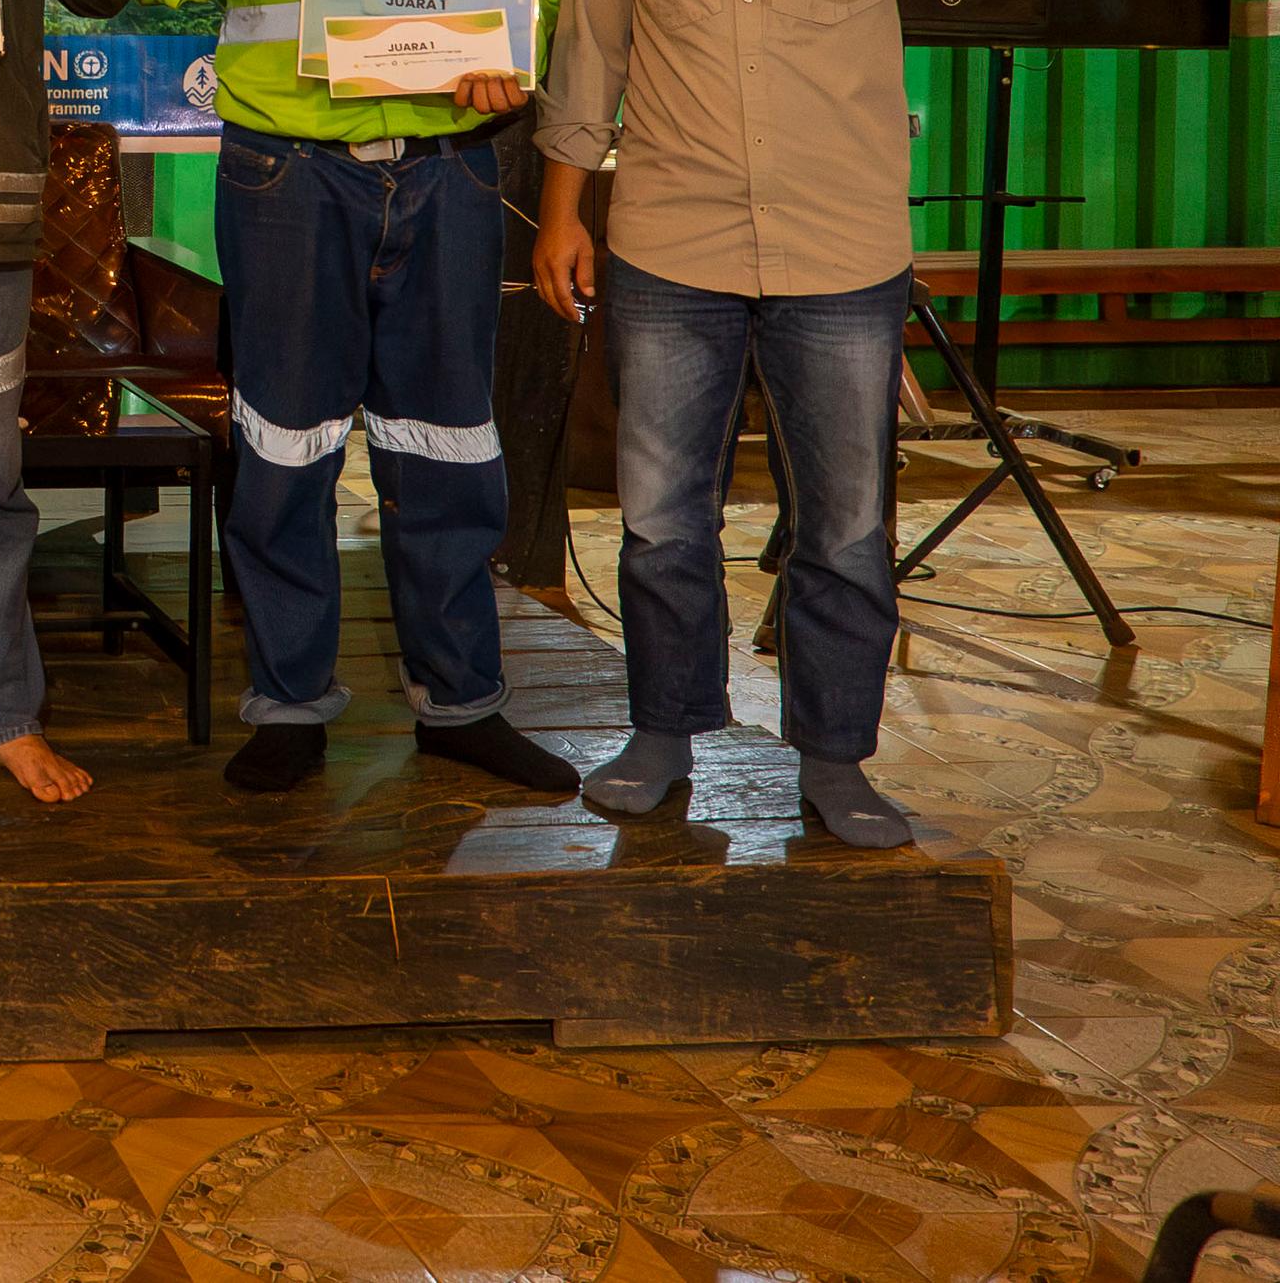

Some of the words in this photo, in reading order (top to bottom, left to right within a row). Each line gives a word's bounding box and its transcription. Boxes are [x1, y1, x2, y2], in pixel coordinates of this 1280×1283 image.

[440, 0, 446, 10] 1
[388, 42, 428, 53] JUARA
[430, 41, 435, 49] 1
[43, 50, 68, 81] N
[47, 87, 109, 100] ronment
[48, 104, 101, 115] ramme
